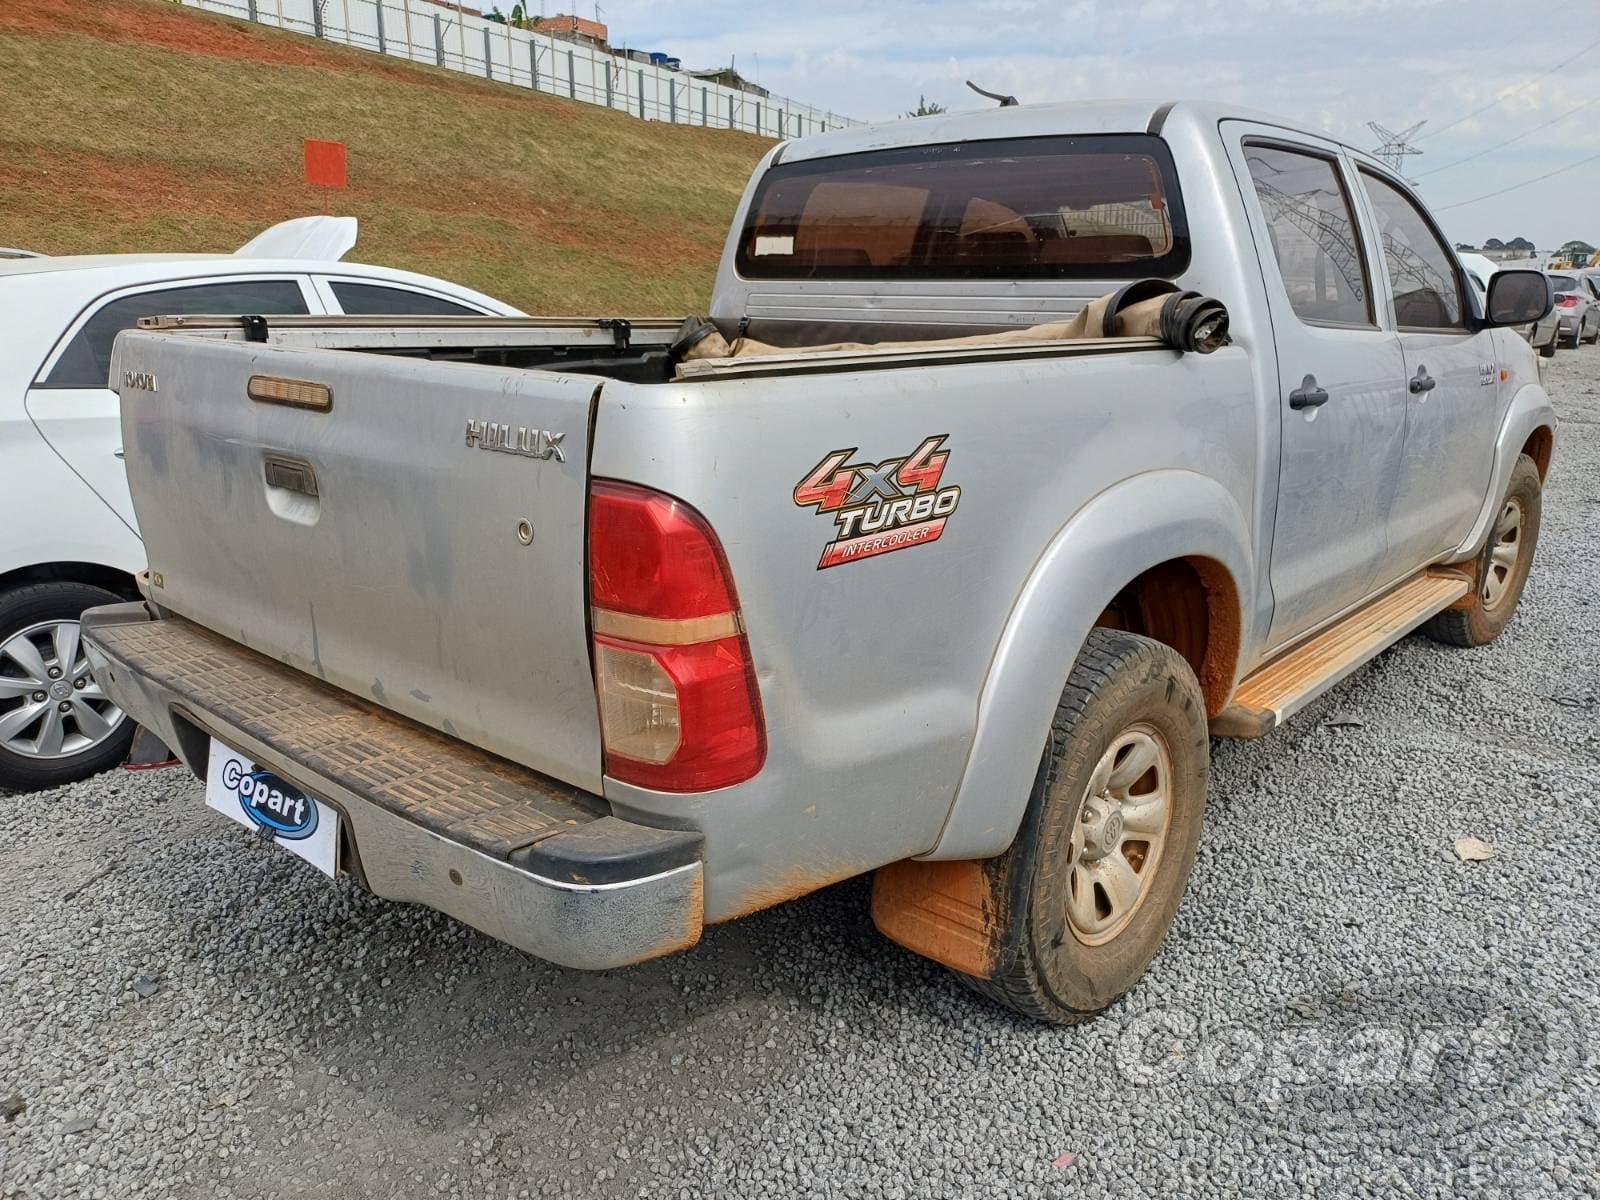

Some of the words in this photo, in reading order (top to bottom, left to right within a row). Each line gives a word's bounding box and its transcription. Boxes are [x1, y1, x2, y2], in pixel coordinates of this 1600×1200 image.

[465, 418, 566, 463] HILUX
[835, 486, 961, 539] TURBO
[841, 526, 929, 558] INTERCOOLER
[222, 758, 305, 825] Copart
